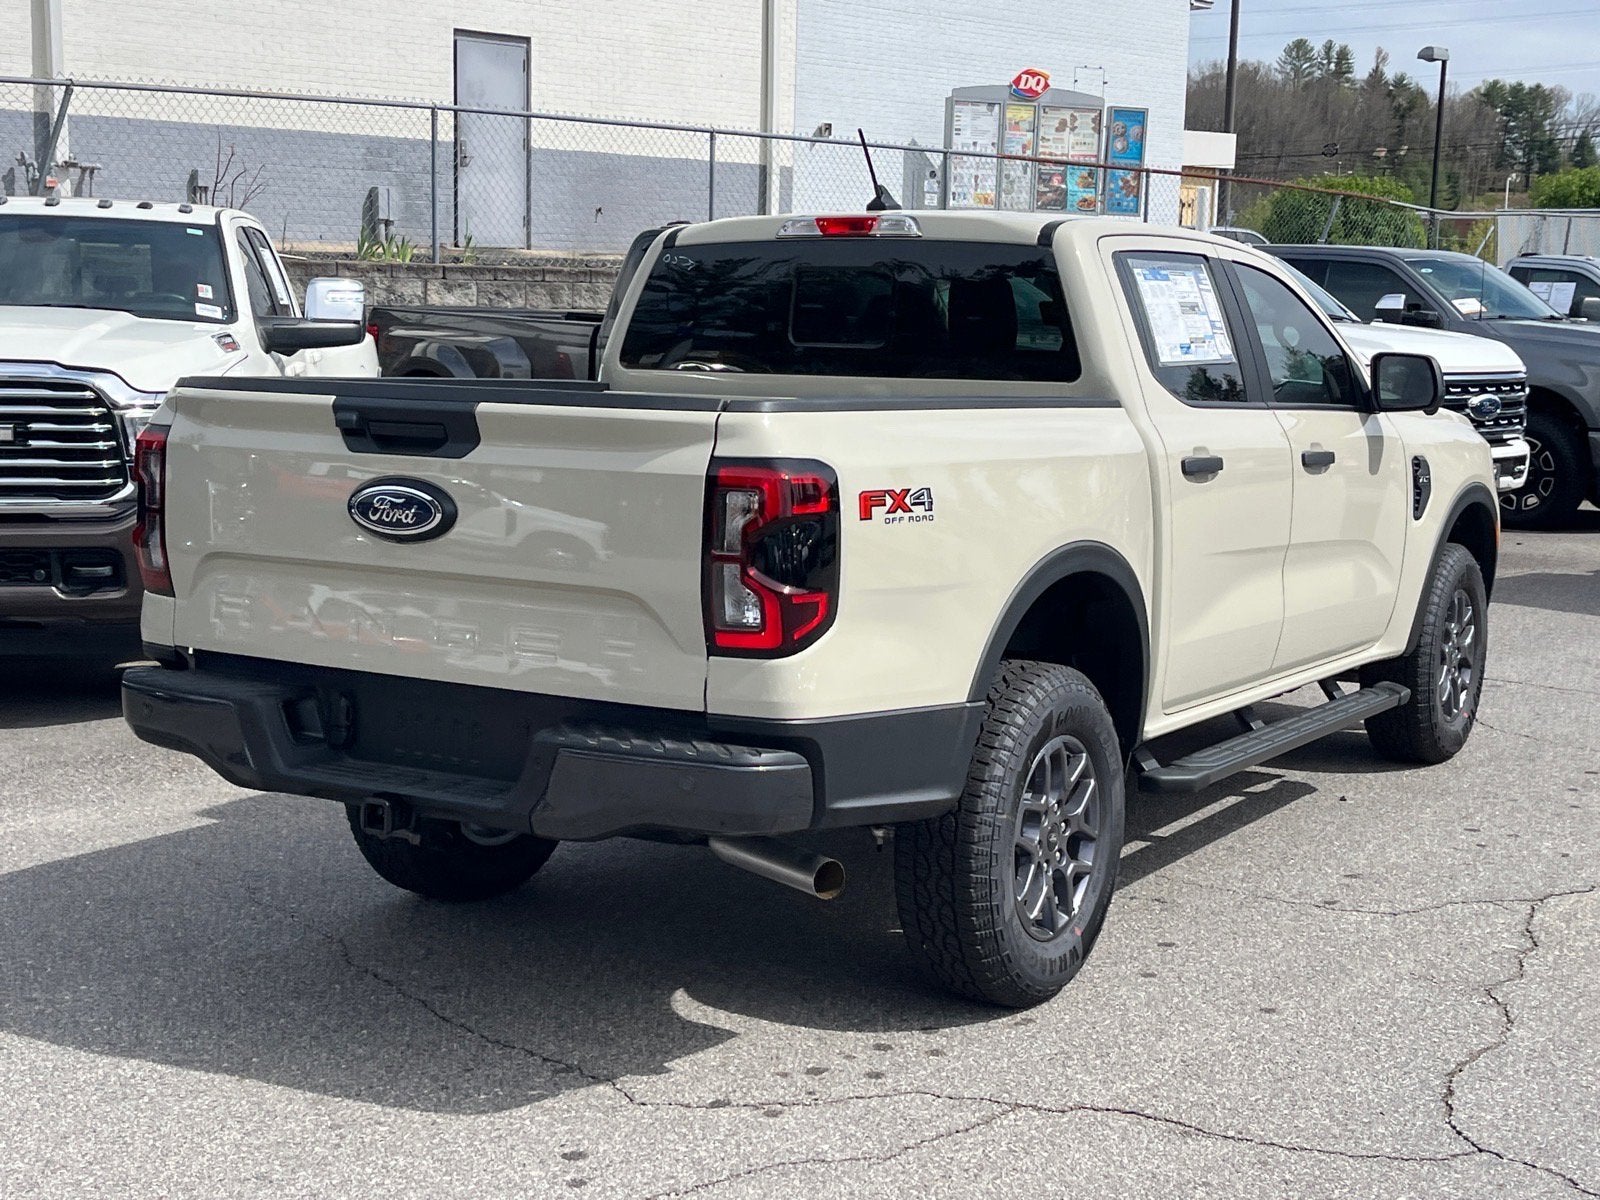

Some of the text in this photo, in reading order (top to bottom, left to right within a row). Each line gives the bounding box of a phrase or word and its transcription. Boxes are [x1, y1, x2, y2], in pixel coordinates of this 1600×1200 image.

[1018, 74, 1046, 93] DQ
[368, 495, 424, 524] Ford
[859, 487, 934, 521] FX4
[884, 514, 935, 525] OFF ROAD
